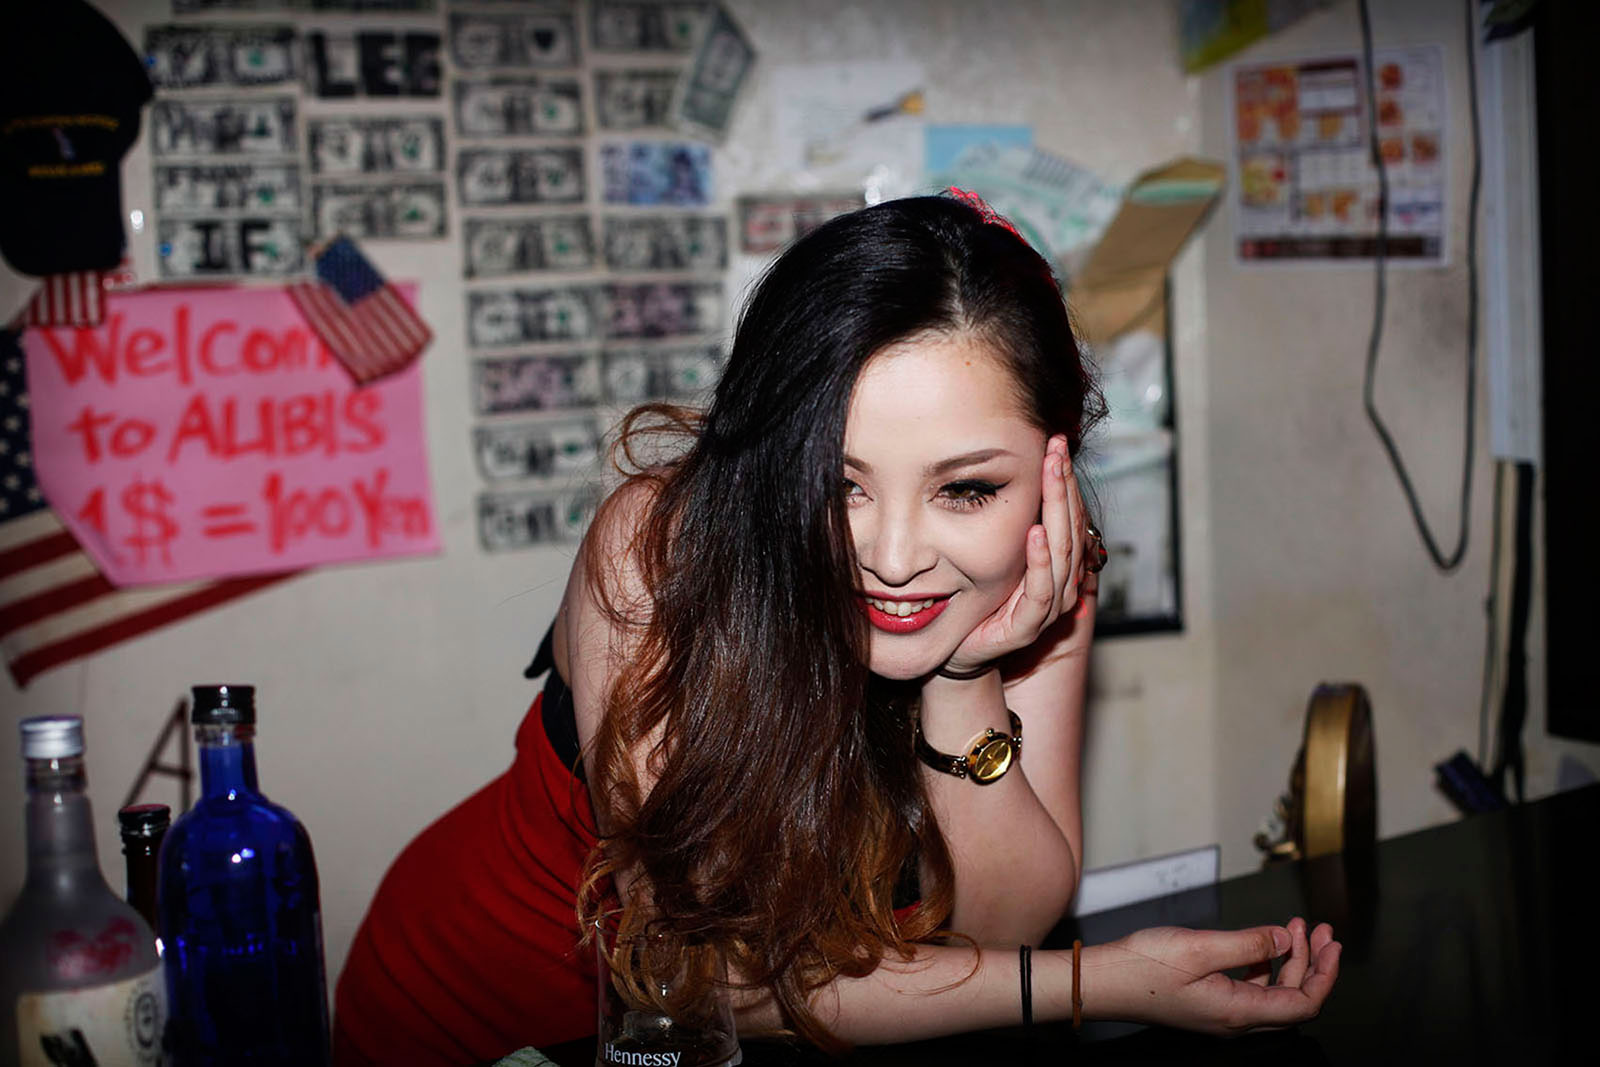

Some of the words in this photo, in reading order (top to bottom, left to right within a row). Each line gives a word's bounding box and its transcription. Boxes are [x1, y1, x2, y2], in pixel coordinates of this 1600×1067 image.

[39, 304, 331, 388] Welcom
[67, 404, 157, 464] to
[167, 390, 386, 463] ALIBIS
[604, 1042, 682, 1067] Hennessy
